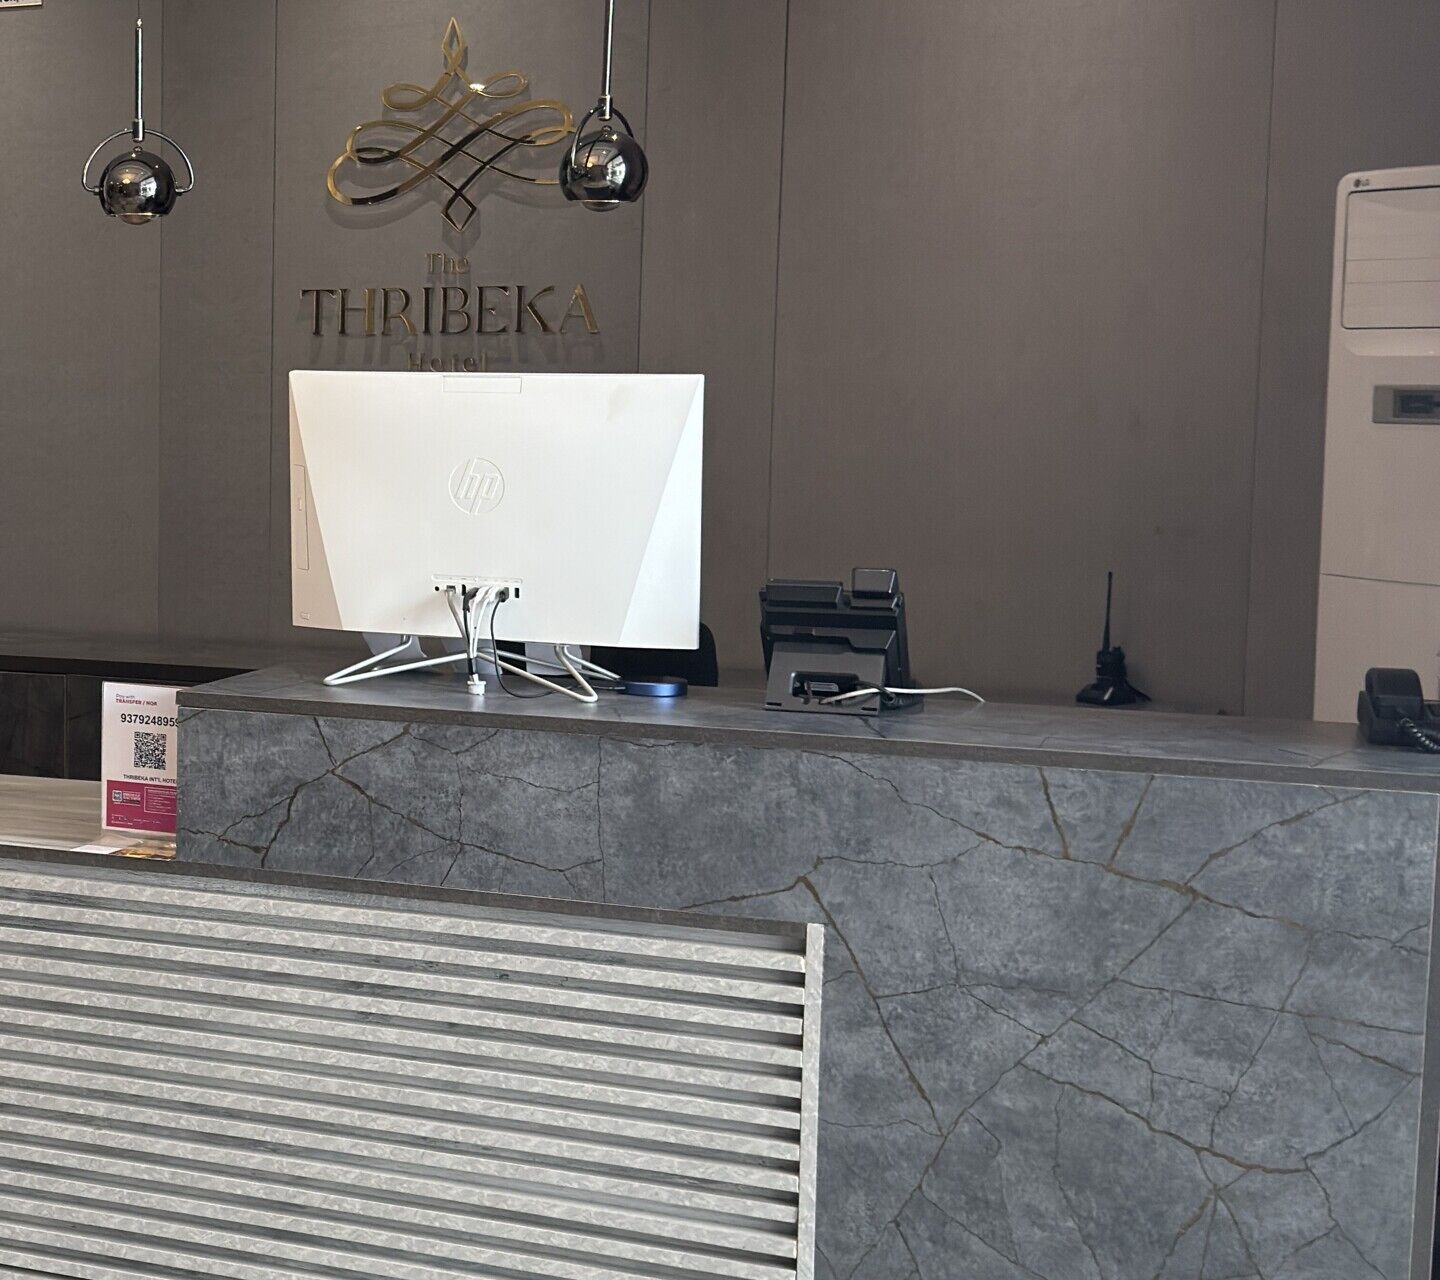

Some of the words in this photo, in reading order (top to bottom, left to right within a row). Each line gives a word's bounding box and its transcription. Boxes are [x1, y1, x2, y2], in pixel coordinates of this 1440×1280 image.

[425, 252, 470, 274] The
[299, 283, 600, 336] THRIBEKA
[408, 351, 487, 372] Hotel
[452, 457, 503, 515] hp
